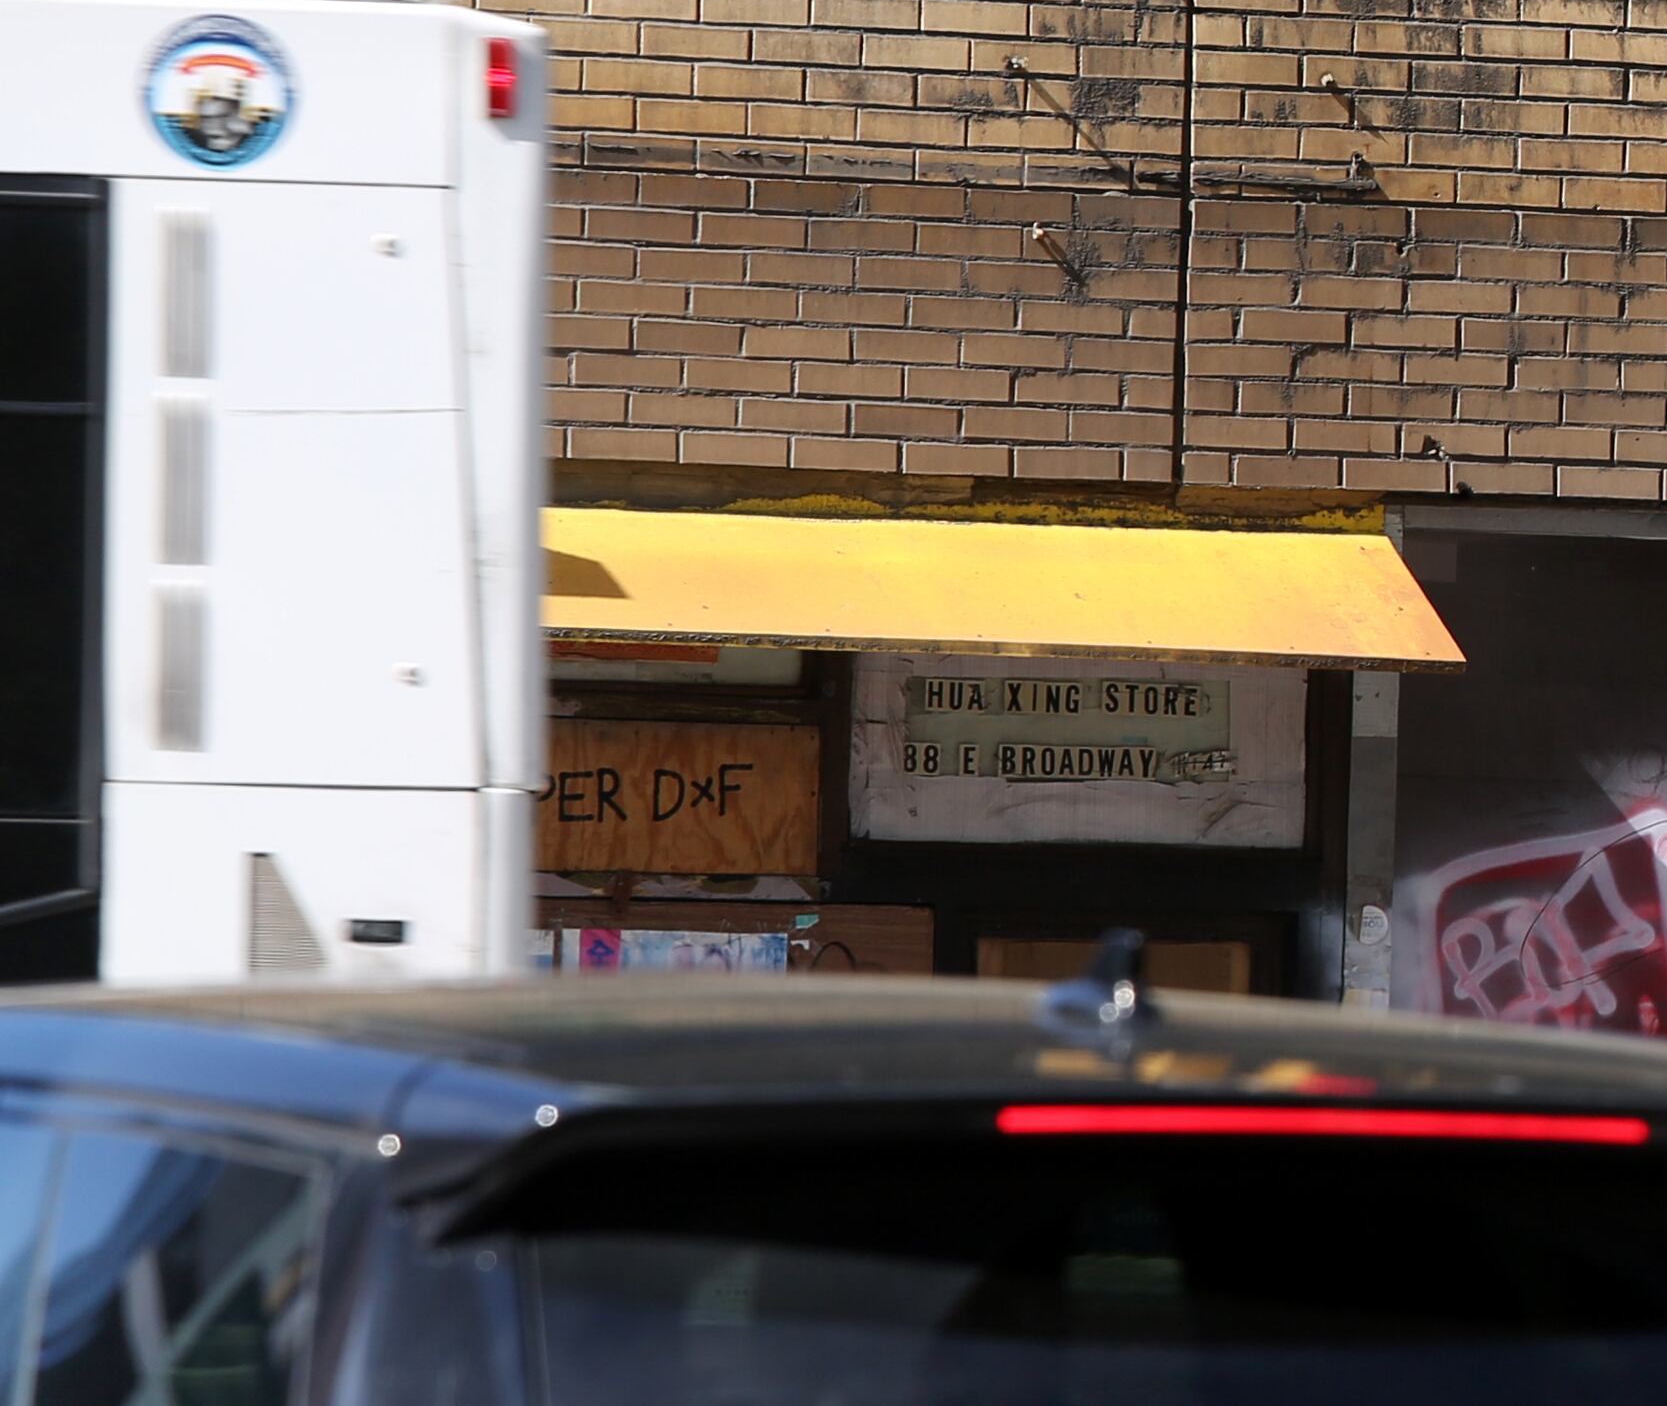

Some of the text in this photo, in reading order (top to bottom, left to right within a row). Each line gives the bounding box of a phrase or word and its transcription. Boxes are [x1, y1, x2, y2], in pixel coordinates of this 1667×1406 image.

[927, 680, 1198, 716] HUA XING STORE
[904, 744, 940, 774] 88
[962, 746, 977, 775] E
[1001, 746, 1156, 778] BROADWAY
